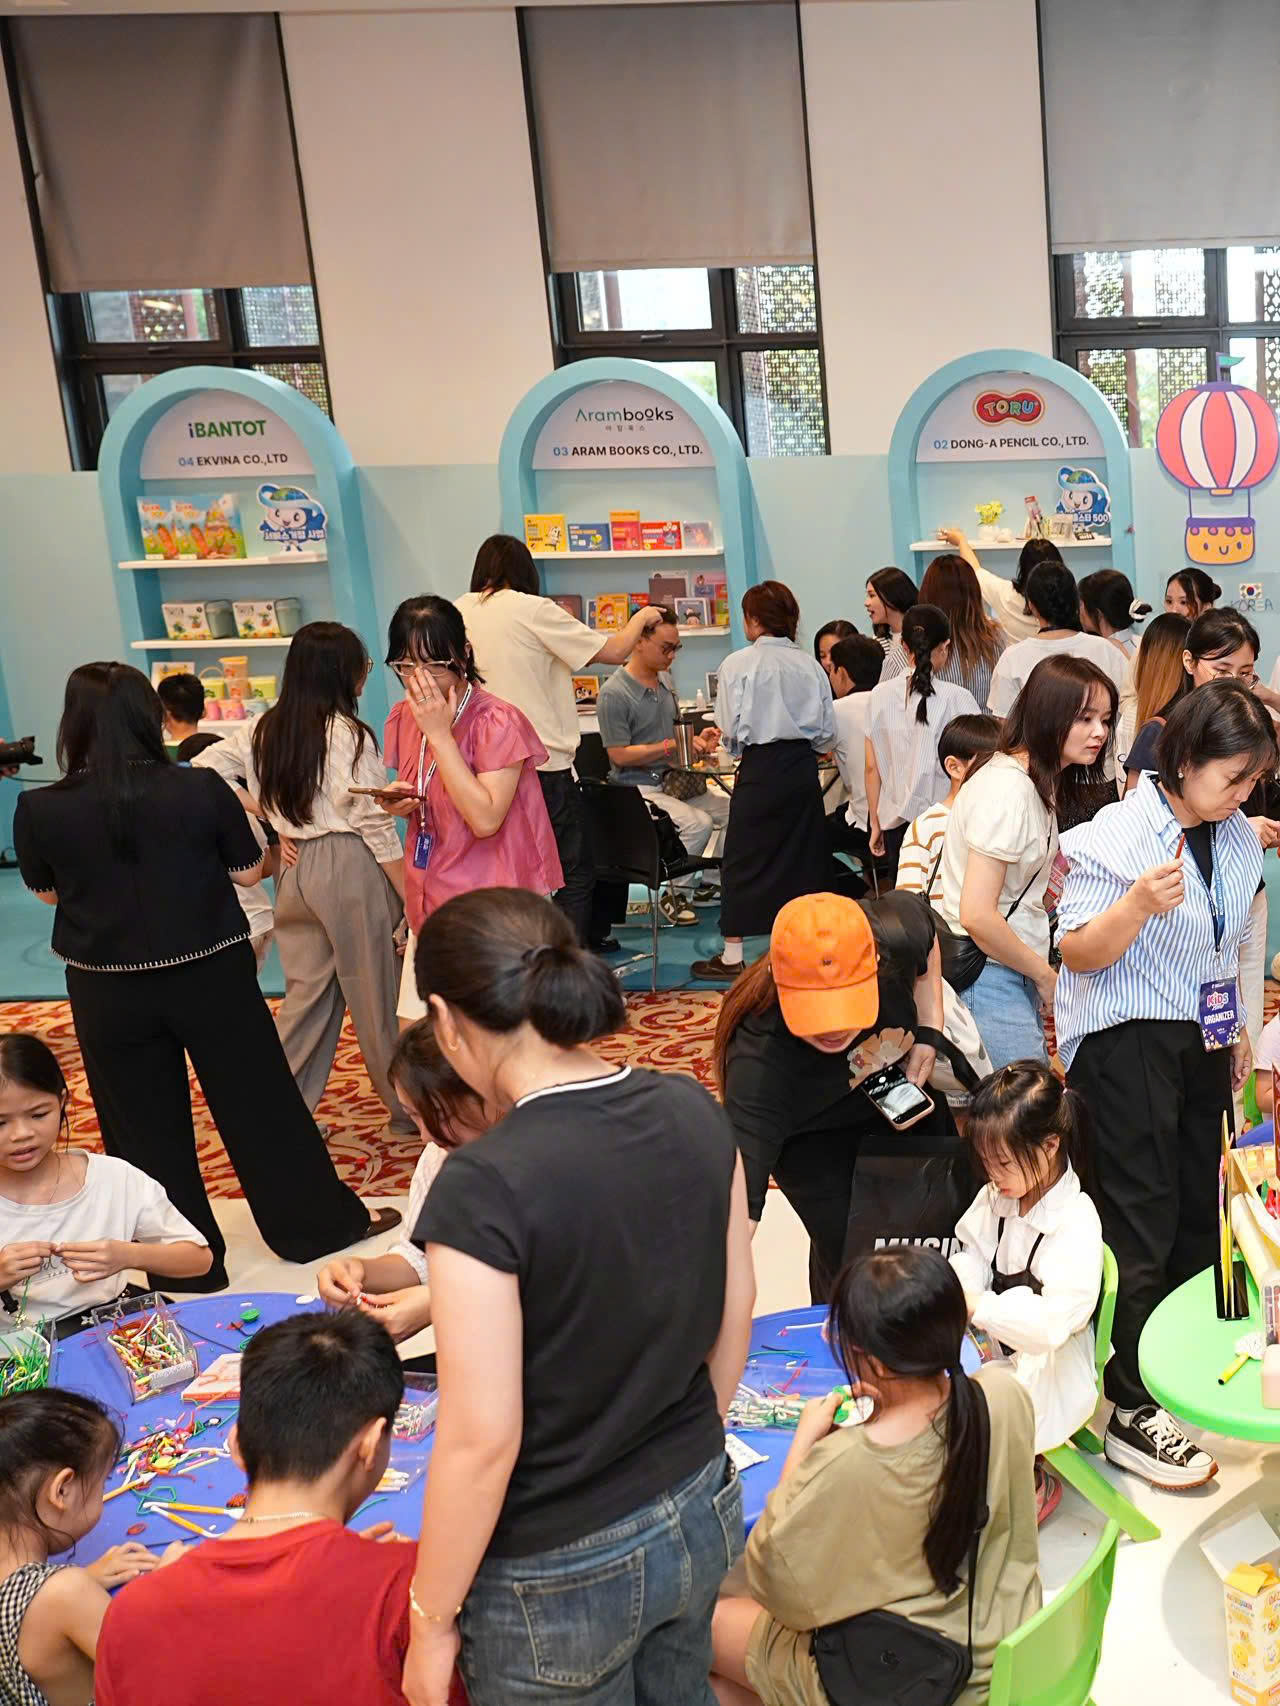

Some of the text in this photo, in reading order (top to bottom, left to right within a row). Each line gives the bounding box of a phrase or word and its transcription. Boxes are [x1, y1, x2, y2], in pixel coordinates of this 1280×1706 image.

[576, 407, 674, 423] Arambooks
[983, 400, 1037, 416] TORU
[188, 420, 266, 438] iBANTOT
[934, 436, 1089, 449] 02 DONG-A PENCIL CO., LTD.
[553, 445, 703, 457] 03 ARAM BOOKS CO., LTD.
[179, 457, 193, 466] 04
[197, 456, 240, 466] EKVINA
[1204, 1010, 1234, 1025] ORGANIZER
